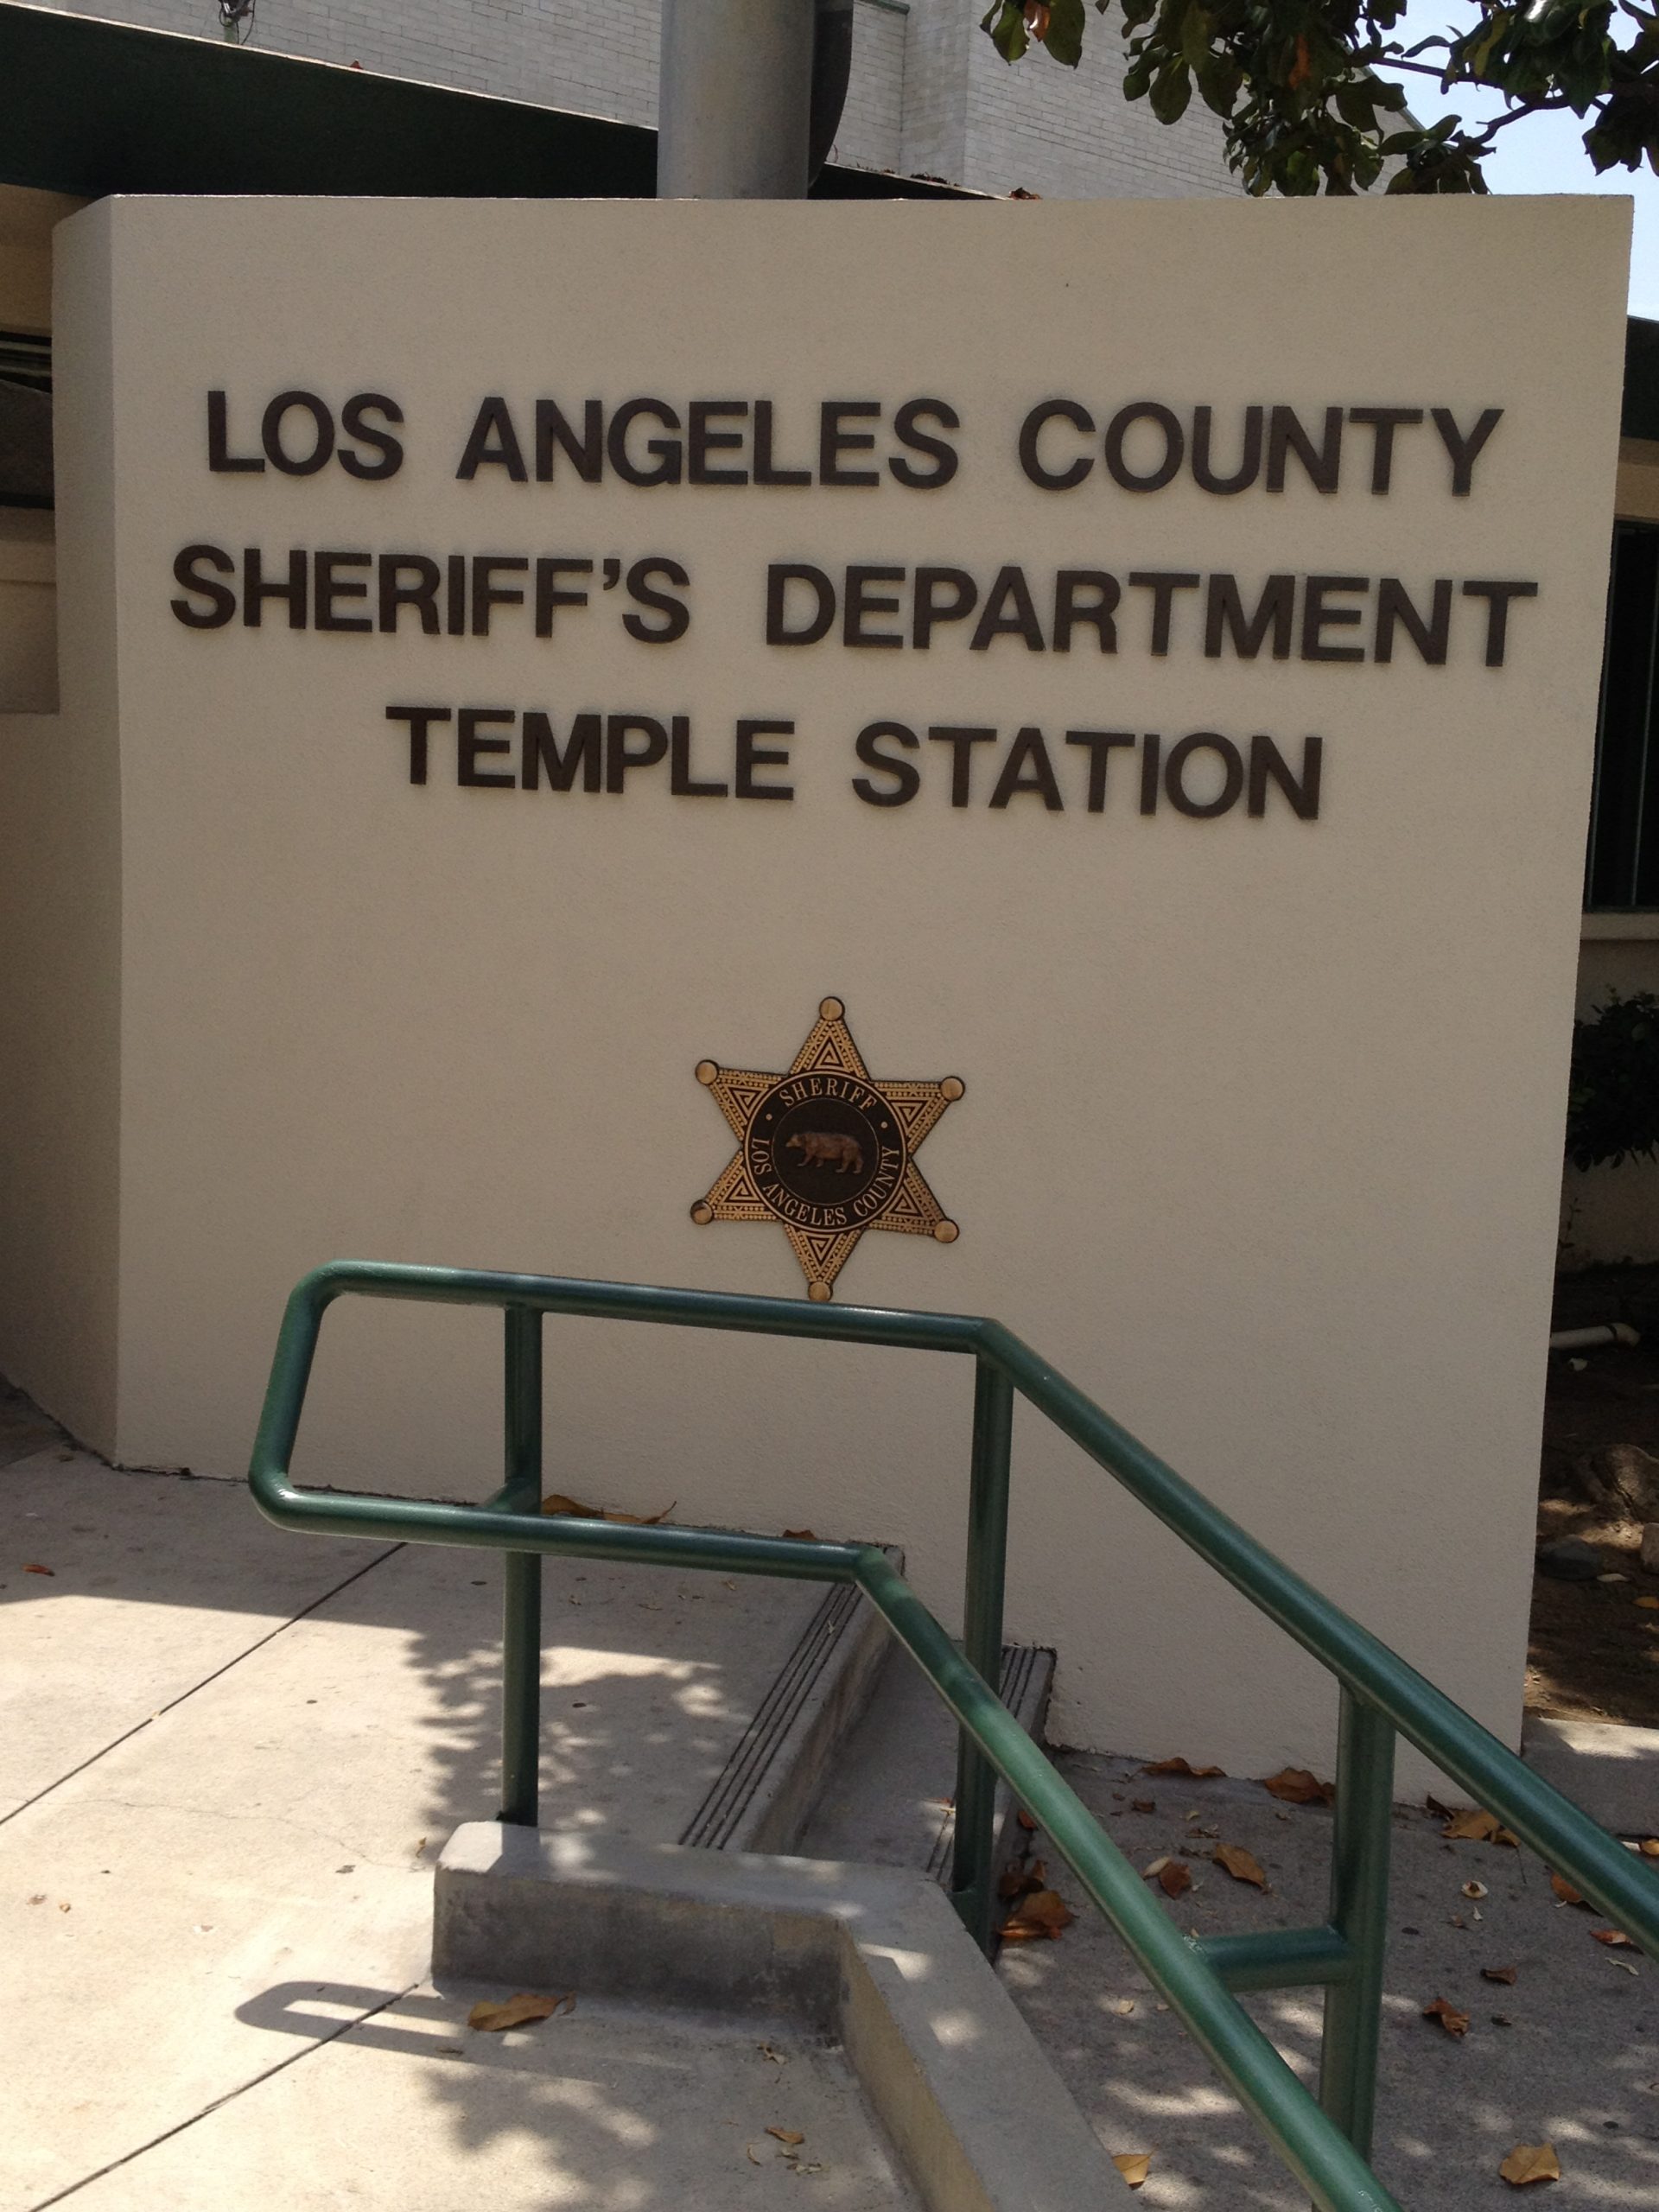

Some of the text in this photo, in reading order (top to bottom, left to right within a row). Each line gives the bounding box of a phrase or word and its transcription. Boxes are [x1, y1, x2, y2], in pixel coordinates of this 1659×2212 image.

[207, 390, 1505, 499] LOS ANGELES COUNTY
[169, 543, 1539, 670] SHERIFF'S DEPARTMENT
[385, 703, 1323, 823] TEMPLE STATION
[779, 1077, 878, 1111] SHERIFF
[750, 1136, 900, 1227] LOS ANGELES COUNTY
